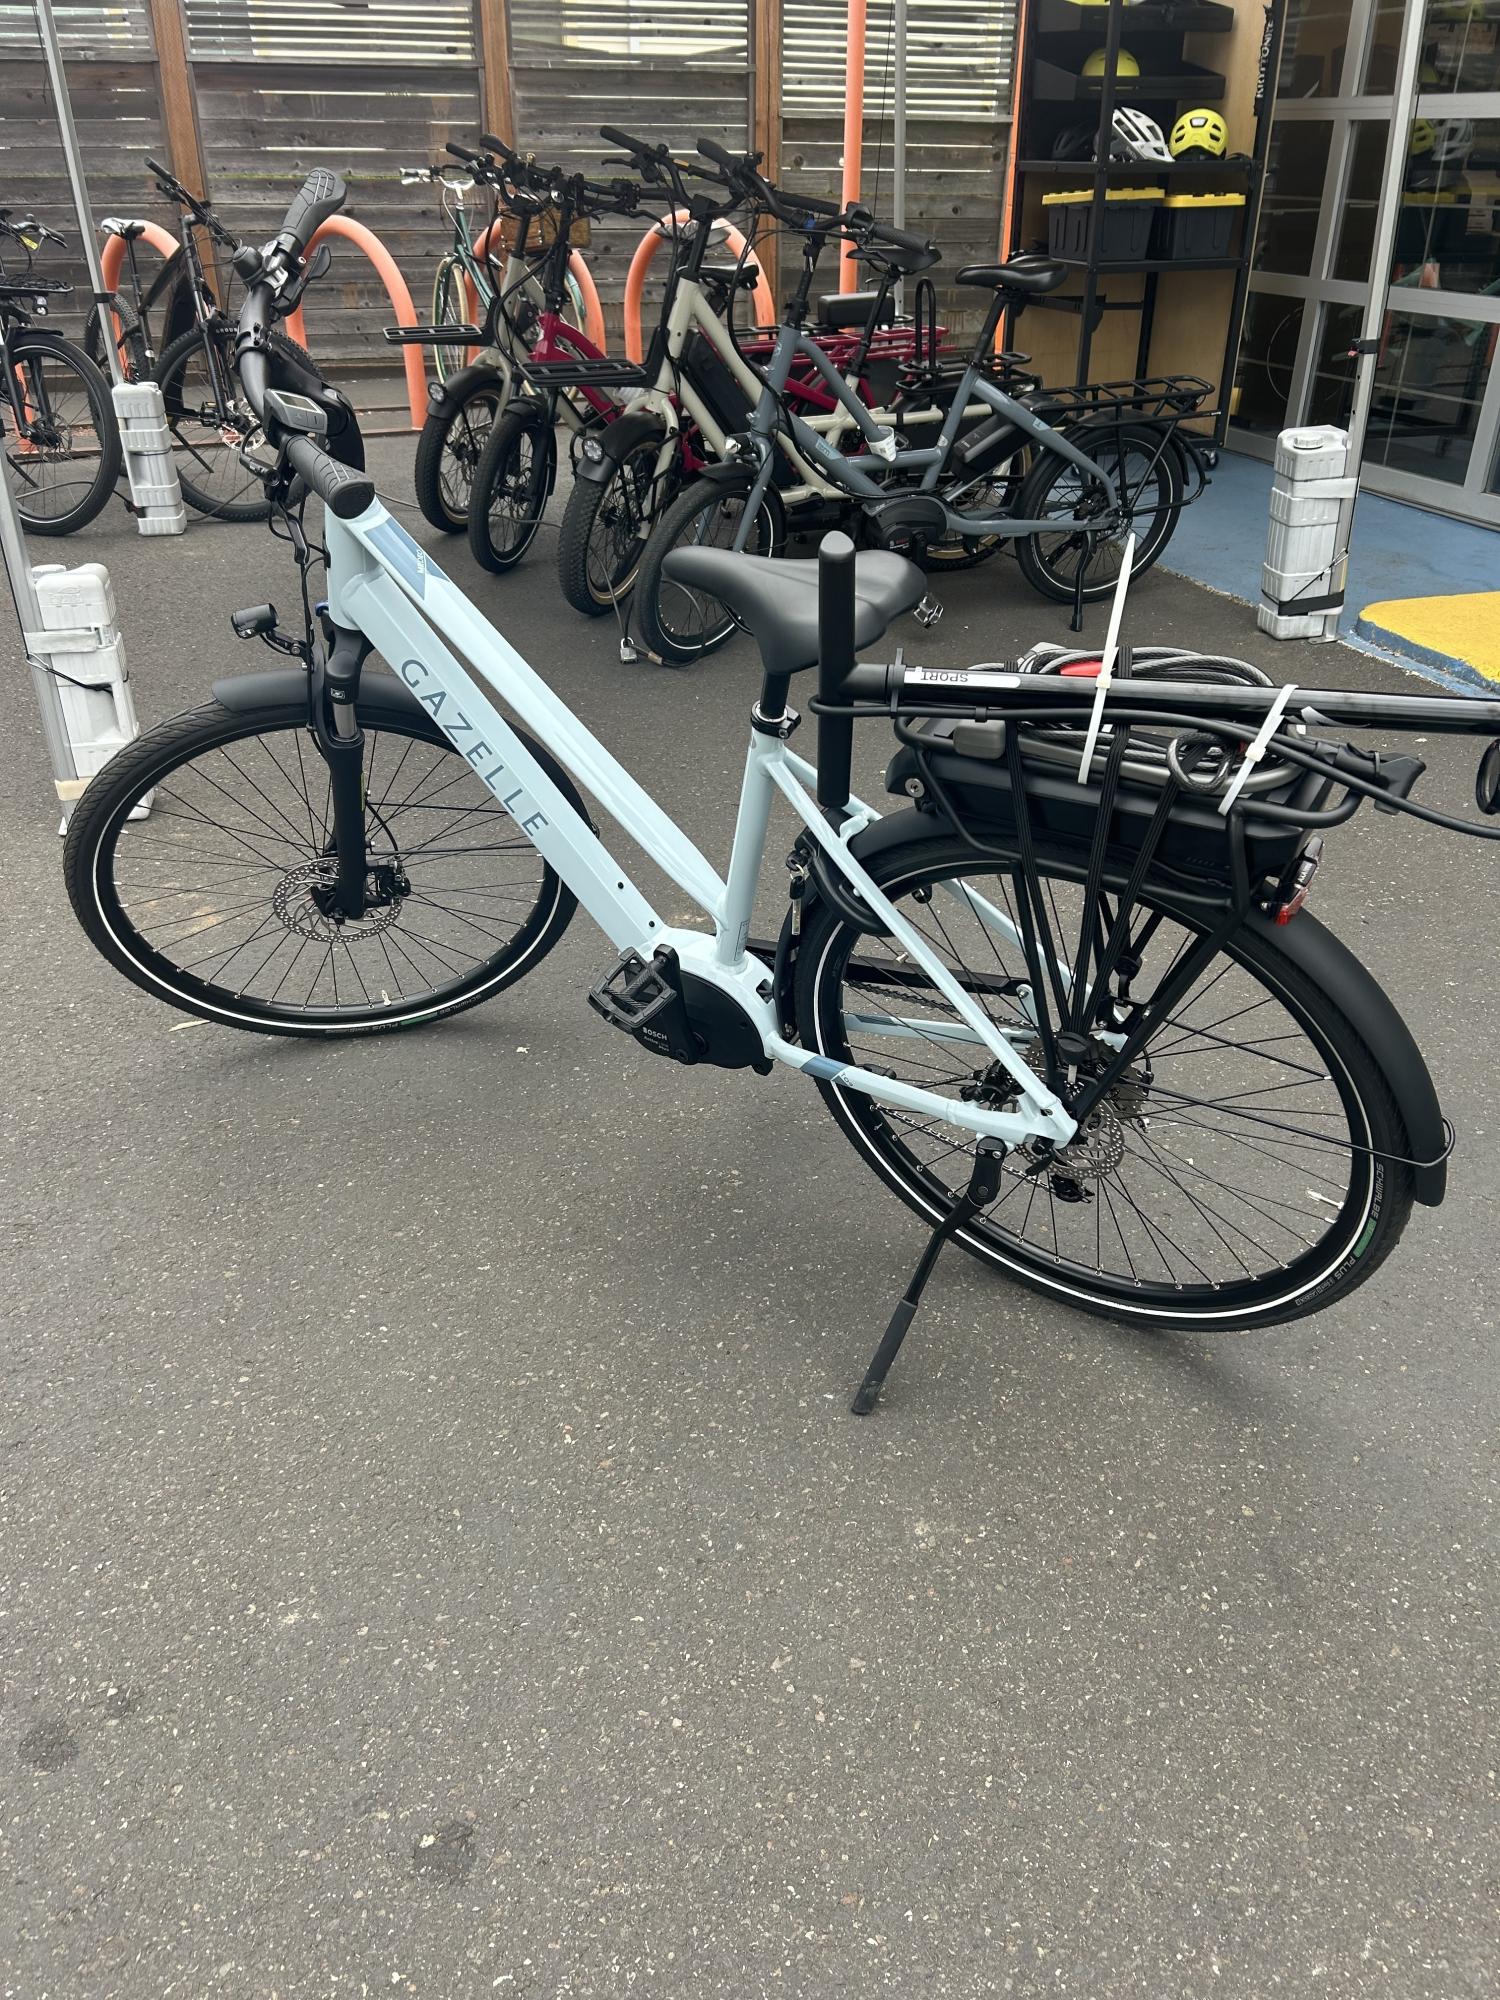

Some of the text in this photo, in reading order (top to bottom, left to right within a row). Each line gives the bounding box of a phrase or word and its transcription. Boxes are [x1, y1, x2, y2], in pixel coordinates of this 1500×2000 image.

[921, 671, 968, 683] SPORT
[401, 659, 549, 837] GAZELLE
[642, 1026, 668, 1041] BOSCH
[1371, 1161, 1385, 1219] SCHWALBE
[1335, 1255, 1357, 1281] PLUS
